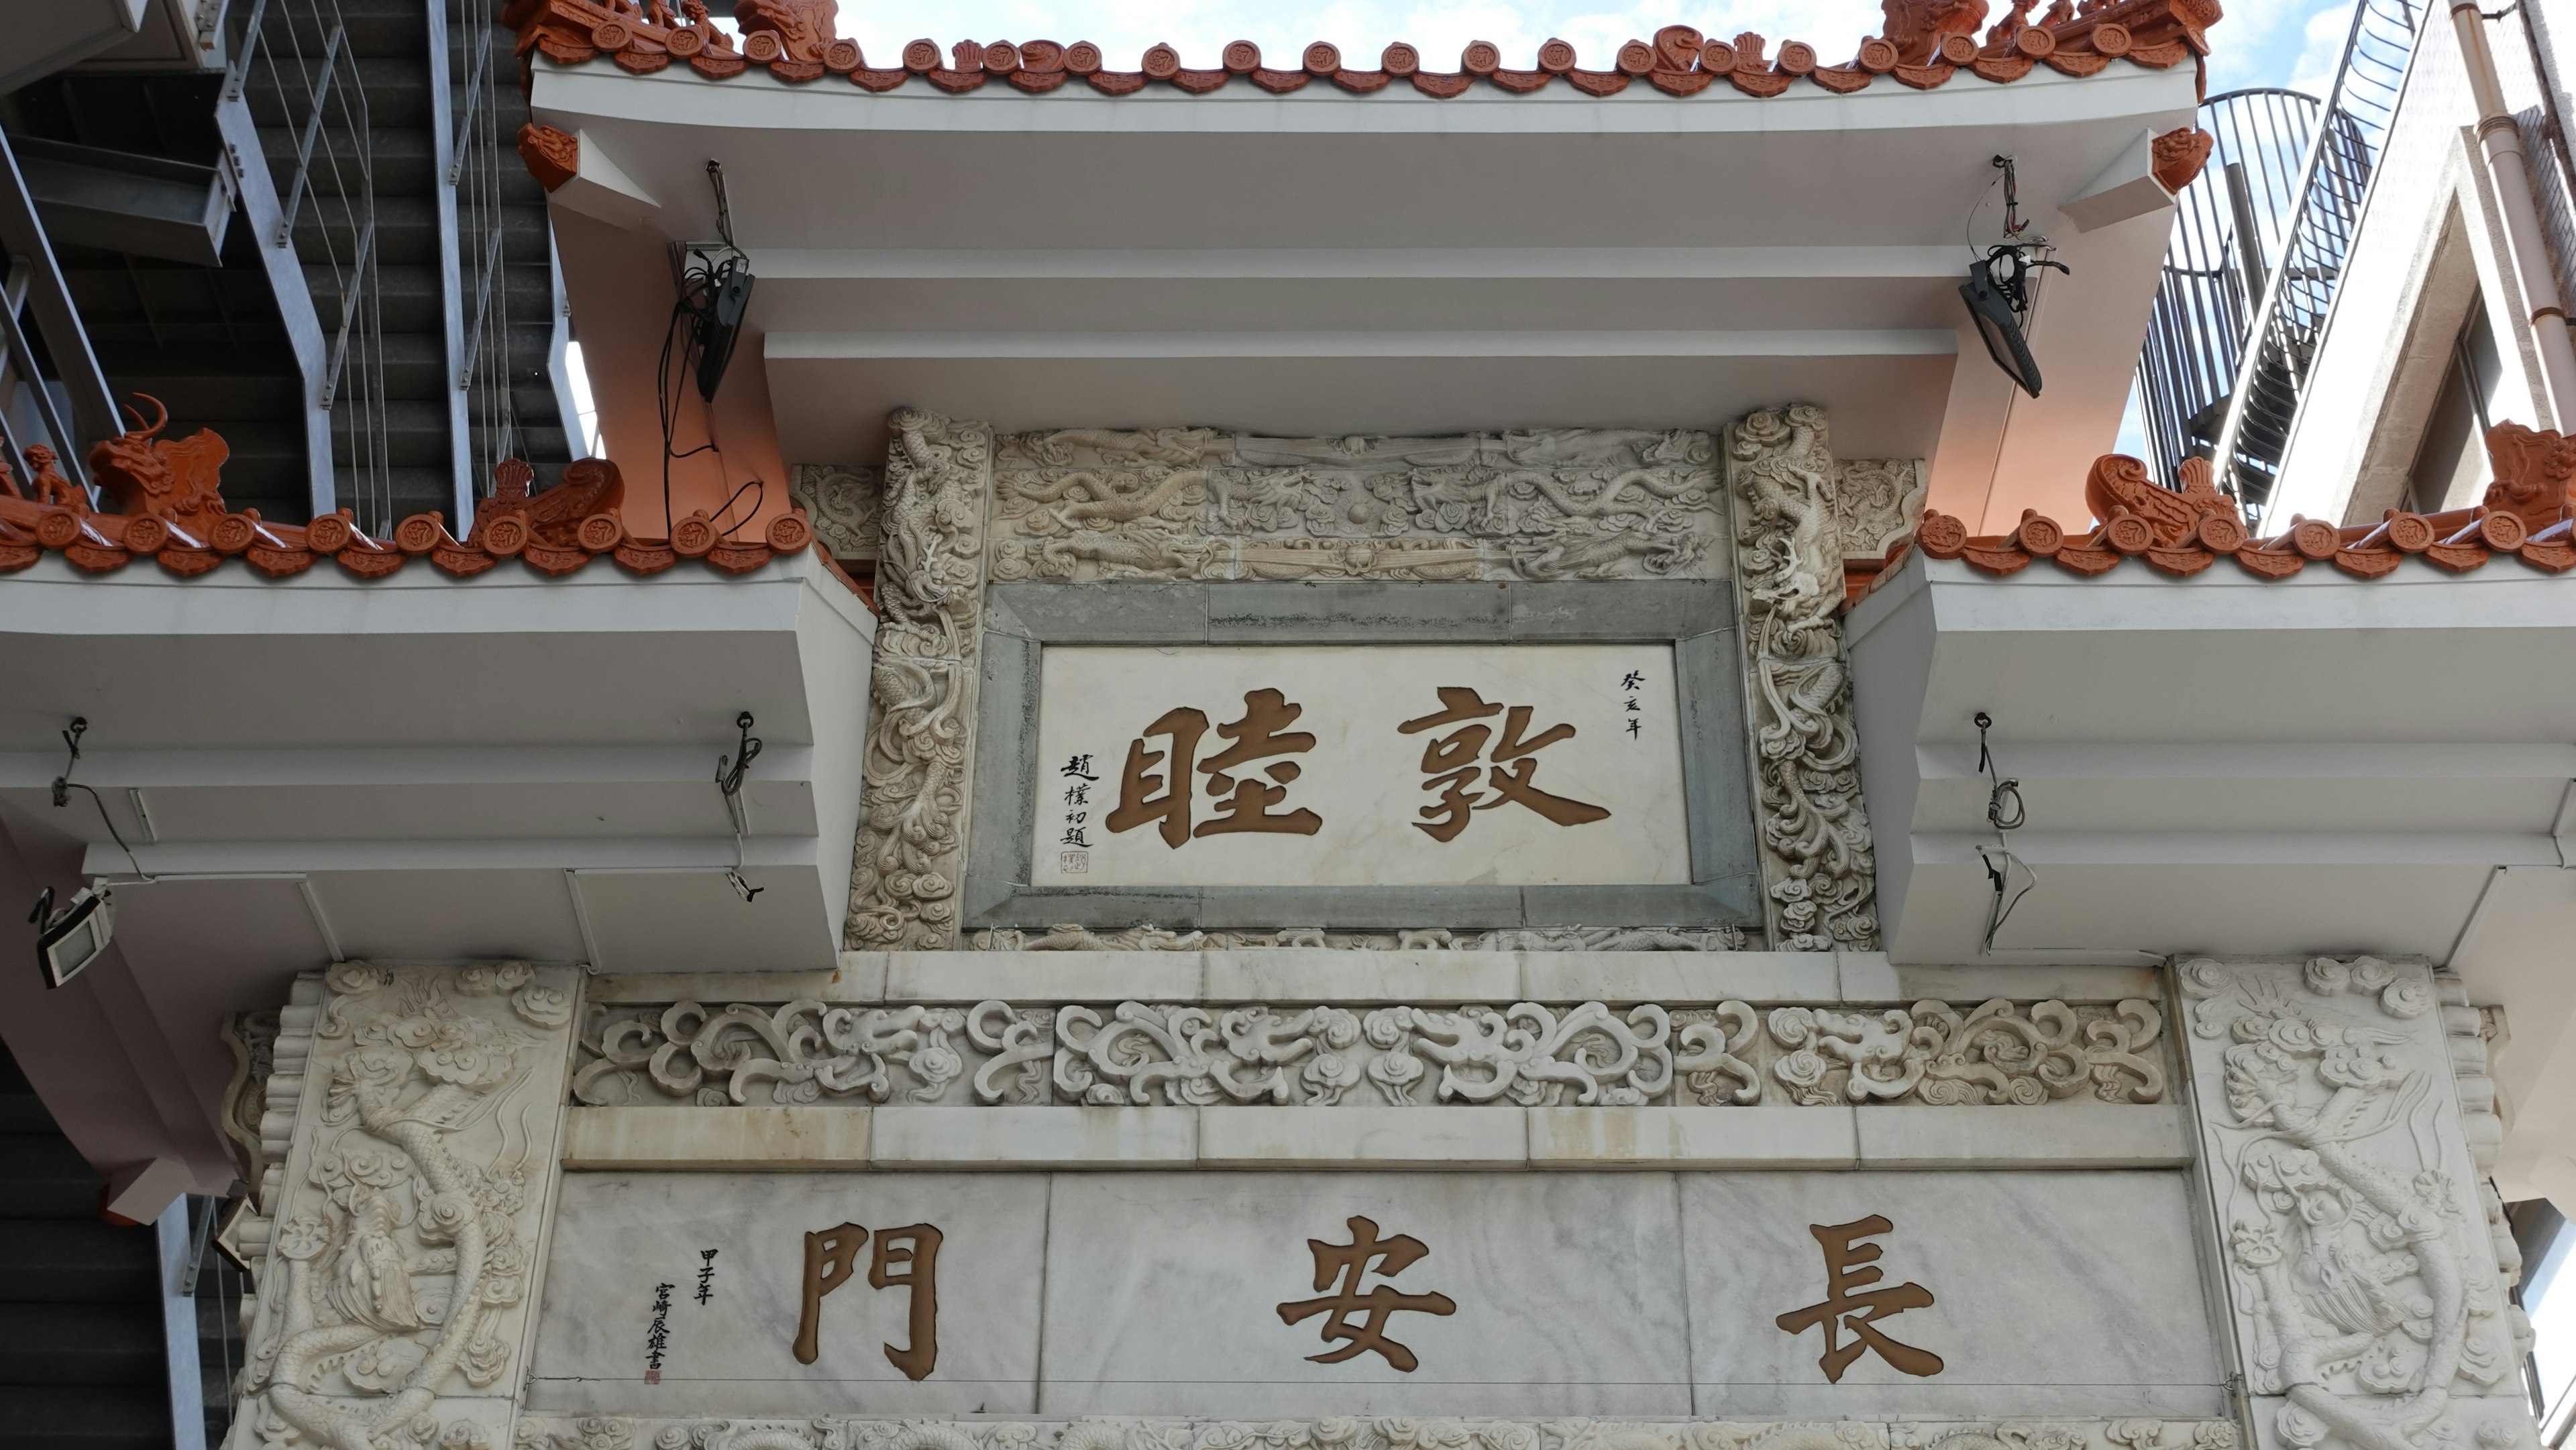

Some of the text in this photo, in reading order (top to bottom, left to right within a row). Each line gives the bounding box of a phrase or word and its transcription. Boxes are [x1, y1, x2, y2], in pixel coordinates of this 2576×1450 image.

[1621, 670, 1646, 740] 癸亥年
[694, 1249, 719, 1306] 甲子年
